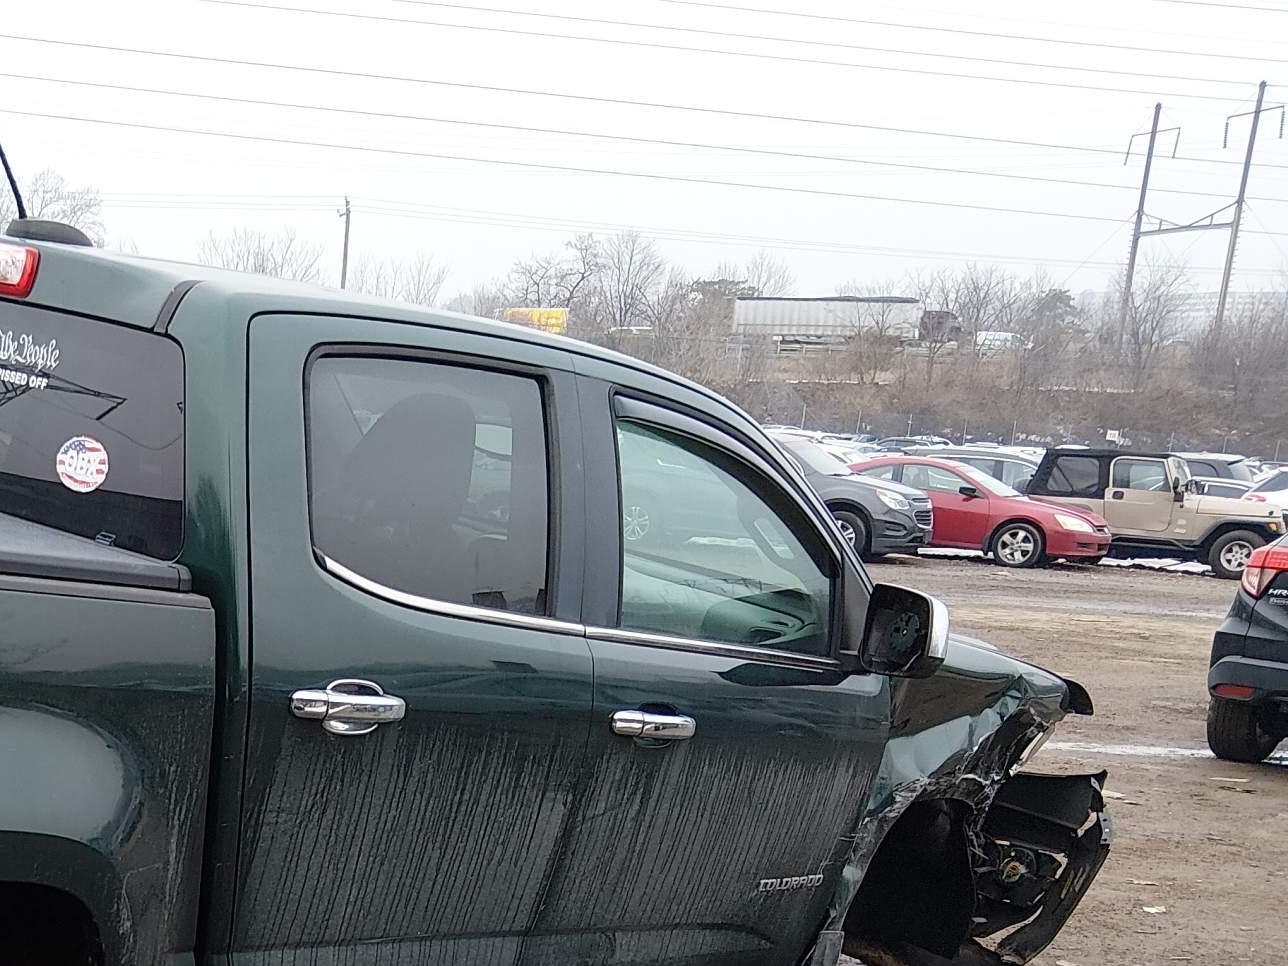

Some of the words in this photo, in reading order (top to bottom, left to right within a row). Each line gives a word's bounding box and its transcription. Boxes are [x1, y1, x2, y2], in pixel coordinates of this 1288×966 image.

[16, 333, 60, 373] People
[29, 375, 49, 390] OFF
[759, 874, 824, 891] COLORADO
